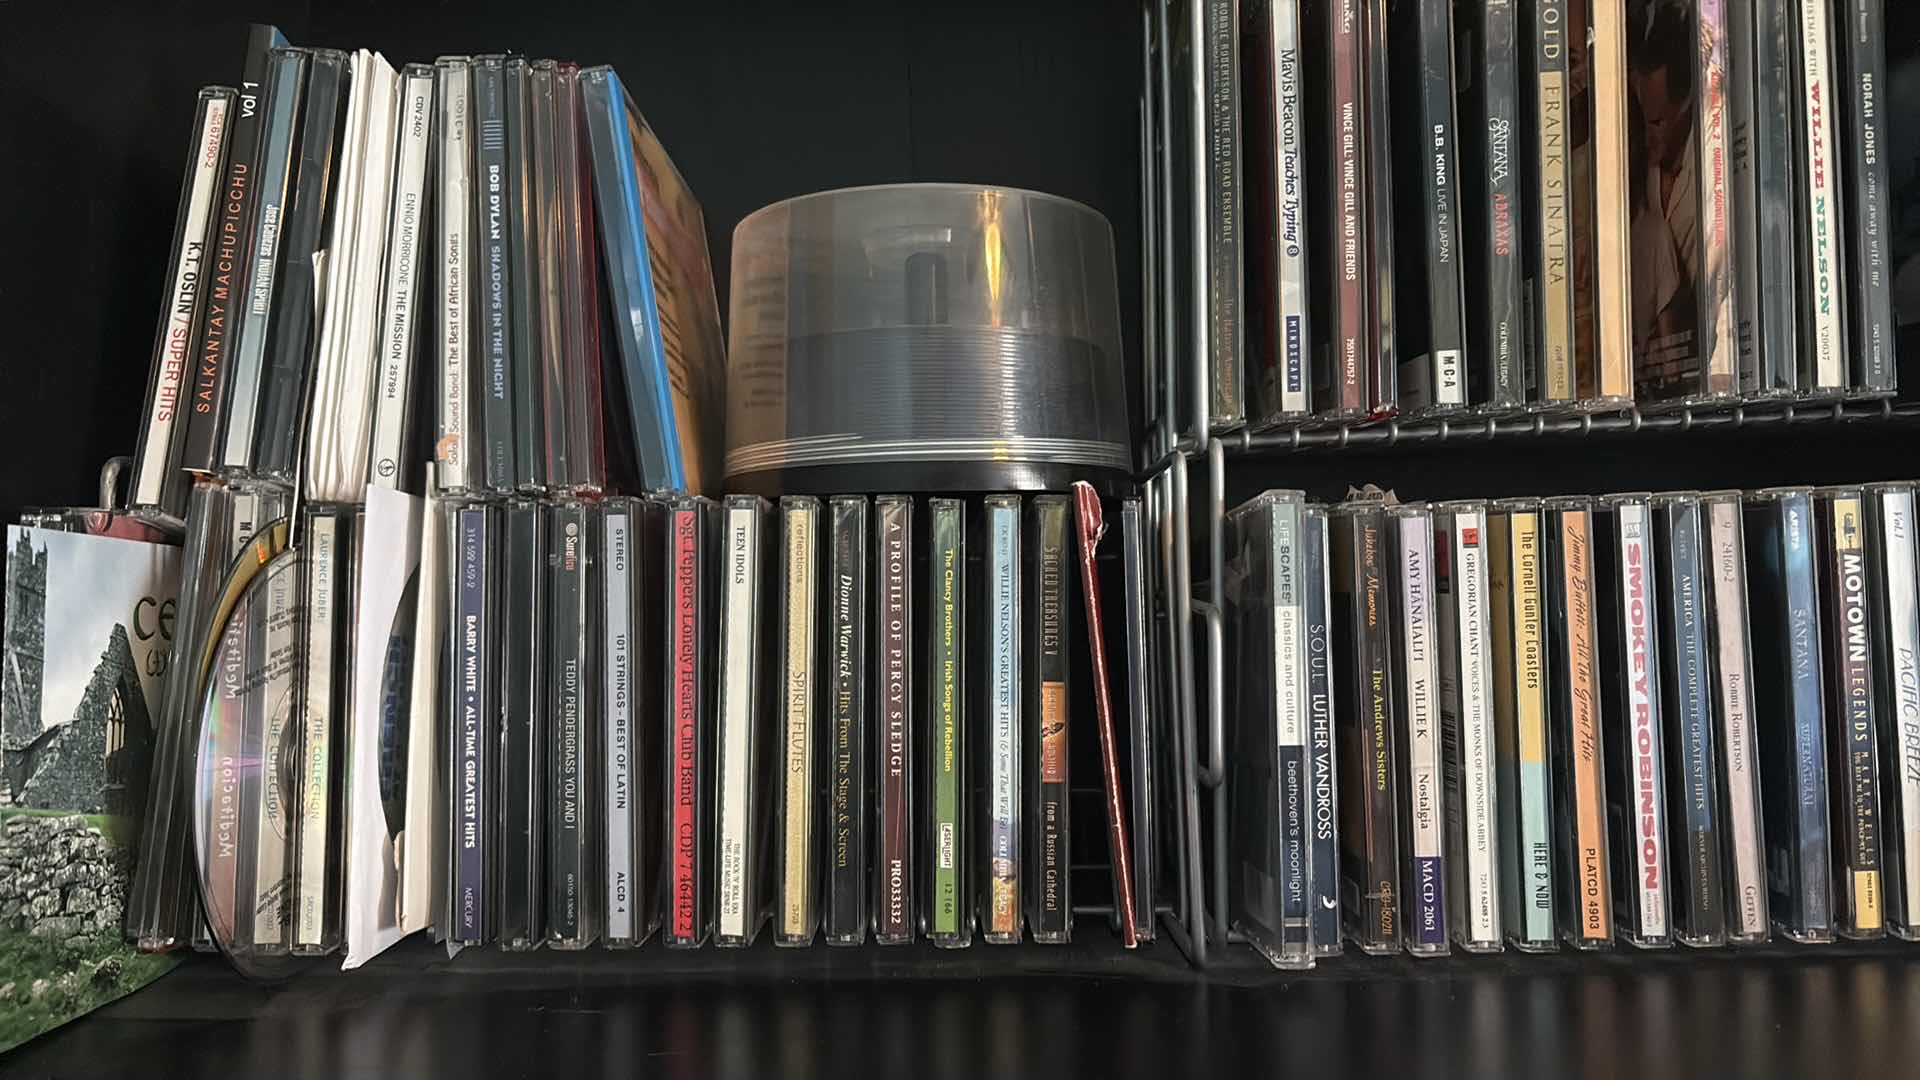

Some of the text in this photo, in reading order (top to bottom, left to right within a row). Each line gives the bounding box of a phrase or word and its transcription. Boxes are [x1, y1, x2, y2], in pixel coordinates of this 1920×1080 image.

[240, 81, 259, 118] vol 1
[1343, 102, 1353, 132] VINCE
[1280, 48, 1300, 244] Mavis Beacon Teaches Typing
[1344, 160, 1355, 188] VINCE
[1344, 190, 1355, 213] GILL
[1434, 124, 1449, 263] B.B. KING LIVE IN JAPAN
[1488, 117, 1510, 256] SANTANA ABRAXAS
[1544, 86, 1565, 285] FRANK SINATRA
[1811, 79, 1831, 316] WILLIE NELSON
[1862, 73, 1882, 287] NORAH JONES come away with me
[1345, 214, 1355, 237] AND
[196, 163, 249, 414] SALKANTAY MACHUPICCHU
[391, 193, 417, 360] ENNIO MORRICONE THE MISSION
[489, 164, 504, 399] BOB DYLAN SHADOWS IN THE NIGHT
[1345, 238, 1356, 281] FRIENDS
[157, 241, 202, 423] K.T. OSLIN SUPER HITS
[1287, 319, 1298, 391] MINDSCAPE
[615, 527, 625, 572] STEREO
[735, 525, 746, 585] TEEN IDOLS
[795, 523, 806, 584] reflections
[1567, 526, 1586, 573] Jimmy
[1789, 509, 1801, 551] ARISTA
[316, 532, 331, 619] LAURENCE JUBER
[679, 546, 695, 610] Peppers
[840, 574, 852, 621] Dionne
[1000, 563, 1010, 600] WILLIE
[1681, 574, 1693, 627] AMERICA
[1000, 602, 1010, 654] NELSON'S
[1520, 530, 1538, 690] The Cornell Gunter Coasters
[1626, 543, 1650, 697] SMOKEY
[1843, 553, 1867, 663] MOTOWN
[679, 612, 695, 665] Lonely
[839, 624, 852, 677] Warwick
[889, 521, 902, 777] A PROFILE OF PERCY SLEDGE
[942, 549, 954, 772] The Clancy Brothers Irish Songs of Rebellion
[1576, 633, 1590, 658] All
[1685, 633, 1695, 656] THE
[1794, 608, 1810, 681] SANTANA
[681, 667, 694, 721] Hearts
[1000, 655, 1010, 707] GREATEST
[1577, 659, 1592, 683] The
[1686, 658, 1700, 720] COMPLETE
[464, 615, 477, 849] BARRY WHITE ALL-TIME GREATEST HITS
[615, 633, 627, 810] 101 STRINGS BEST OF LATIN
[791, 671, 807, 773] SPIRIT FLUTES
[839, 691, 851, 714] Hits
[839, 718, 851, 746] From
[1000, 709, 1009, 738] HITS
[1310, 624, 1332, 840] S.O.U.L. LUTHER VANDROSS
[1373, 669, 1387, 792] The Andrews Sisters
[1574, 687, 1593, 730] Great
[1851, 667, 1868, 742] LEGENDS
[310, 716, 323, 820] THE COLLECTION
[564, 659, 577, 824] TEDDY PENDERGRASS YOU AND
[680, 722, 694, 762] Club
[838, 751, 851, 774] The
[1581, 731, 1597, 763] Hits
[1690, 721, 1703, 779] GREATEST
[679, 765, 693, 807] Band
[836, 777, 850, 809] Stage
[1416, 773, 1432, 831] Nostalgia
[1635, 703, 1659, 890] ROBINSON
[1695, 782, 1705, 810] HITS
[1861, 751, 1871, 798] MARY
[838, 813, 849, 823] &
[838, 827, 849, 867] Screen
[1287, 760, 1302, 903] beethoven's moonlight
[1865, 808, 1875, 866] WELLS
[679, 822, 694, 919] CDP 46442
[1046, 801, 1058, 912] from a Russian Cathedral
[1533, 842, 1550, 910] HERE & NOW
[464, 887, 473, 928] MERCURY
[616, 872, 627, 902] ALCD
[890, 859, 902, 924] PRO3332
[1421, 859, 1436, 931] MACD 2061
[1585, 848, 1600, 930] PLATCD 4903
